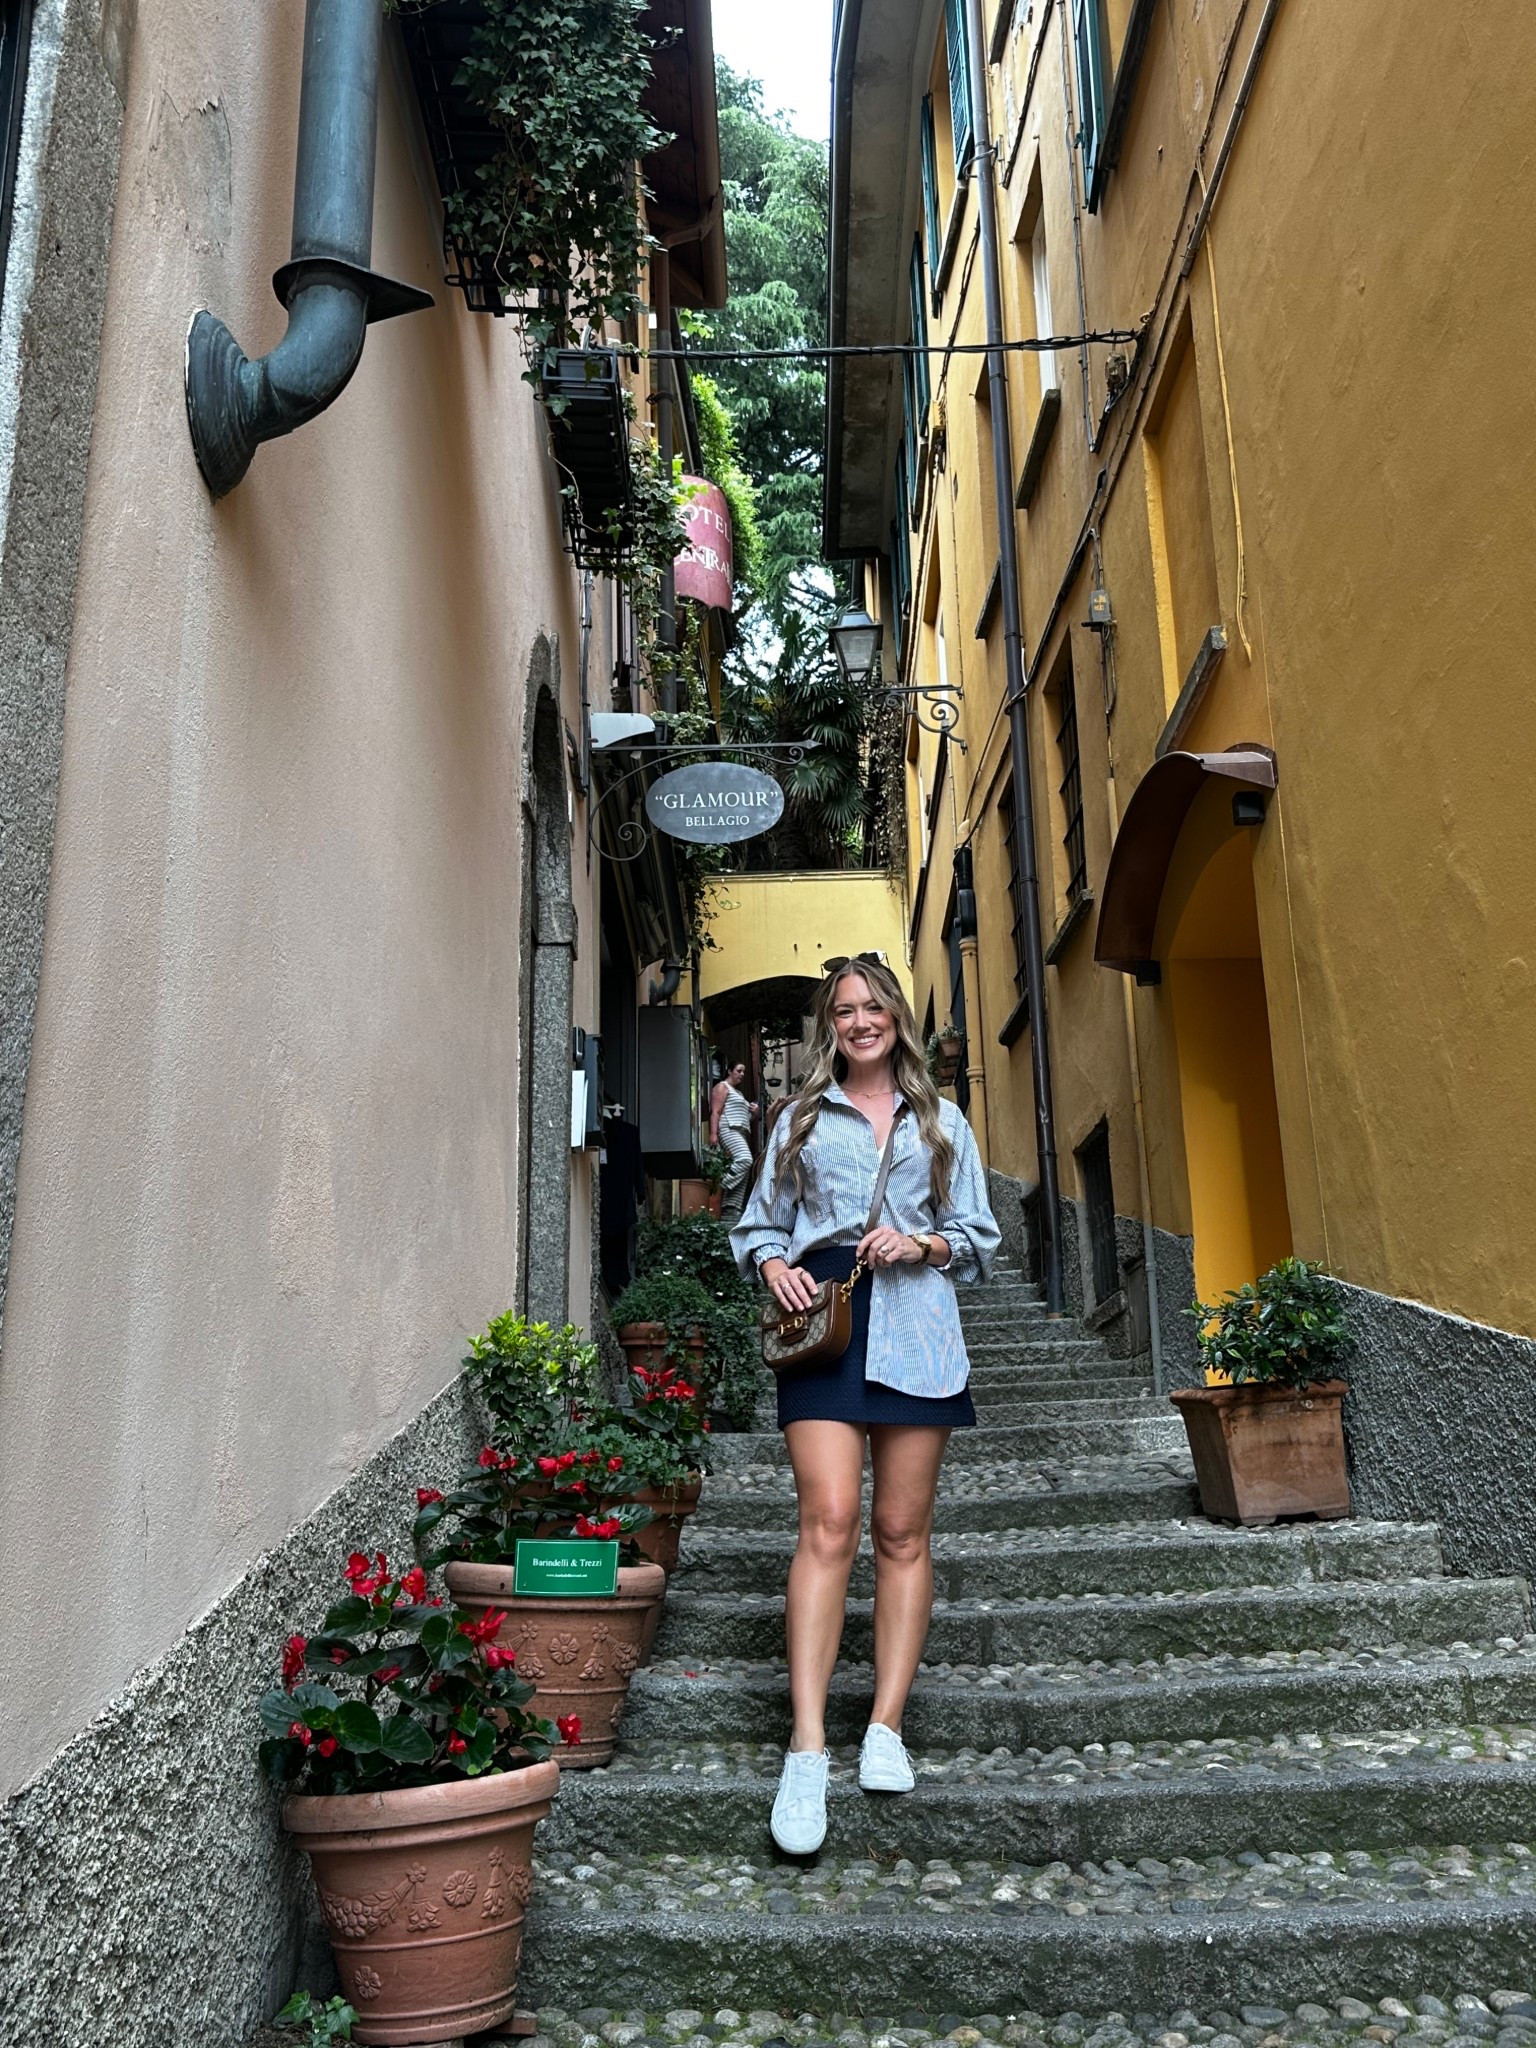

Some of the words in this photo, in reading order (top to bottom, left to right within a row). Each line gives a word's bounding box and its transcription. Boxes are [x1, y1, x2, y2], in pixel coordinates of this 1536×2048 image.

[678, 504, 731, 542] OTEL
[673, 546, 732, 589] ENTRAL
[655, 791, 779, 810] “GLAMOUR”
[685, 815, 750, 827] BELLAGIO
[533, 1558, 569, 1567] Barindelli
[570, 1558, 578, 1567] &
[580, 1558, 602, 1567] Trezzi
